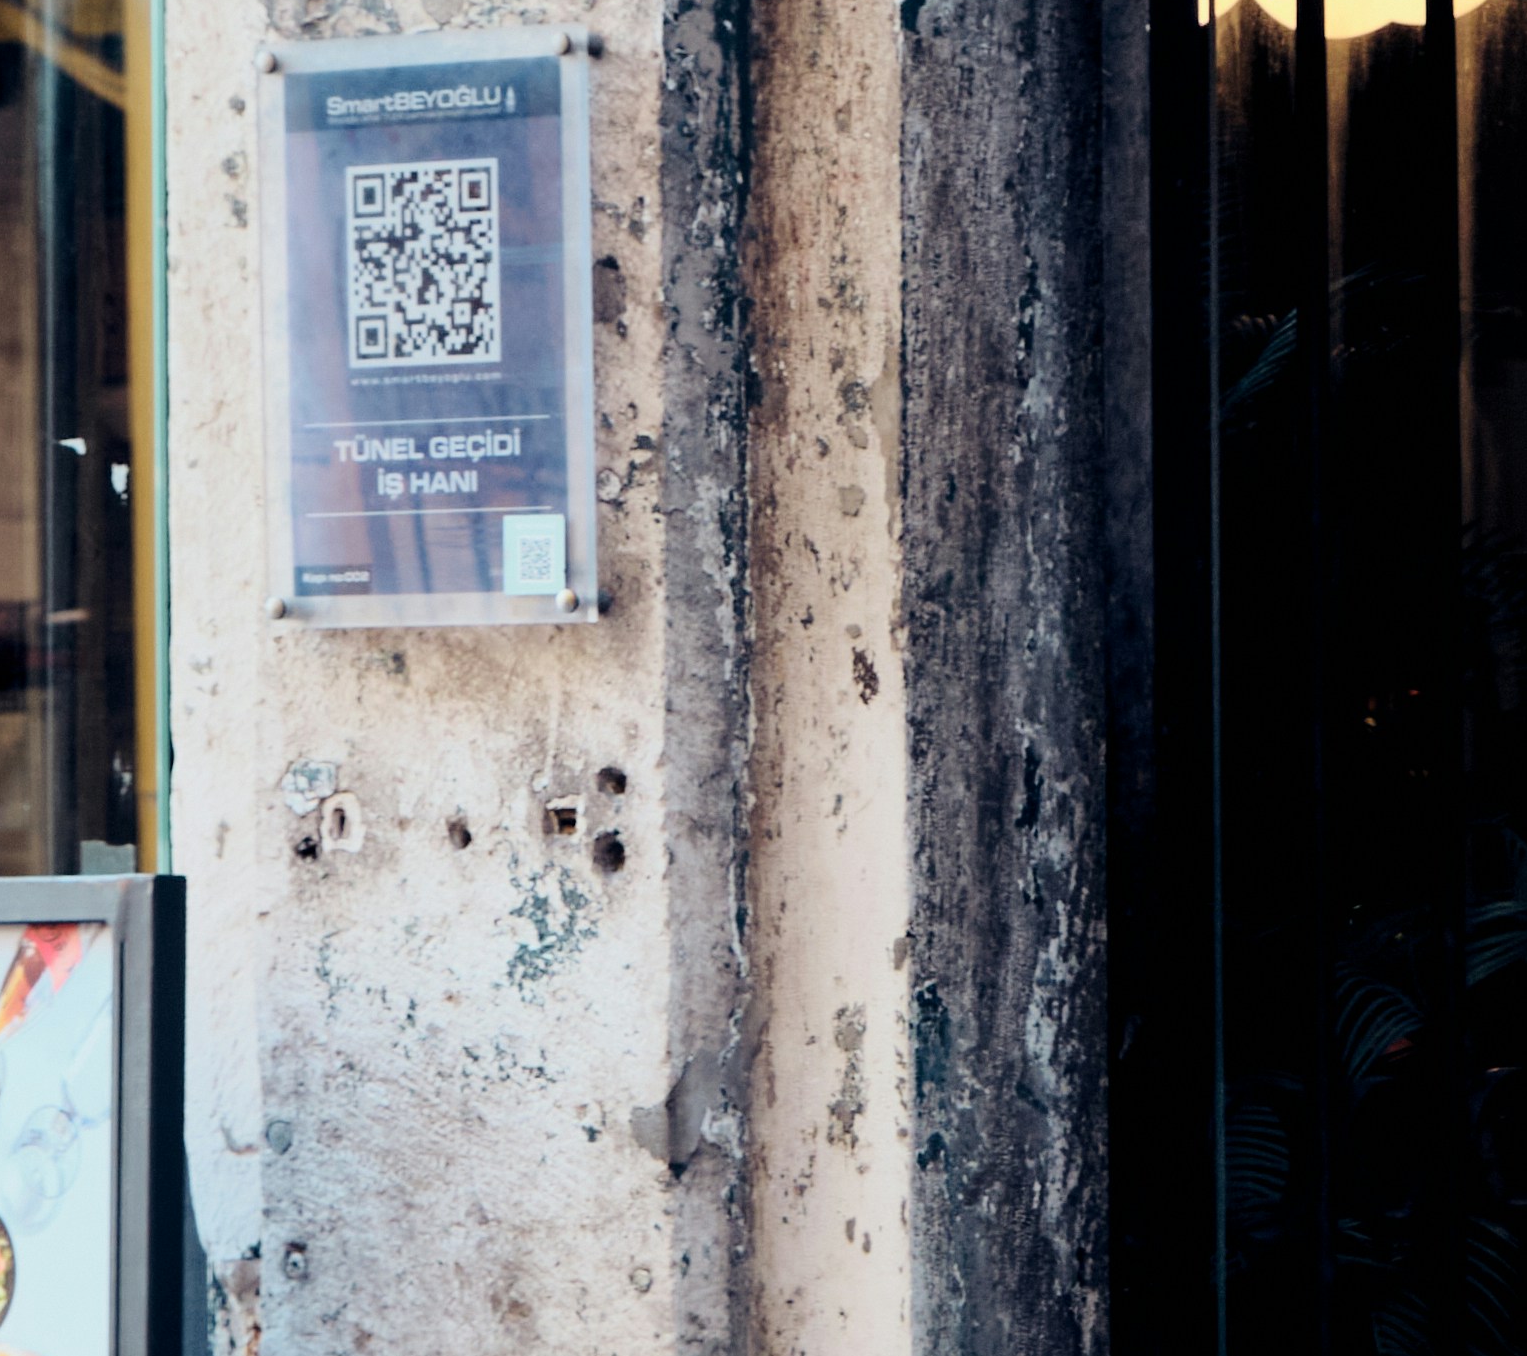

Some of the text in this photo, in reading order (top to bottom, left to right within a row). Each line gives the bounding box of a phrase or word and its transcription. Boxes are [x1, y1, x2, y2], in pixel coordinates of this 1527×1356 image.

[326, 84, 502, 116] SmartBEYOĞLU
[333, 428, 522, 464] TÜNEL GEÇİDİ
[377, 468, 479, 500] İŞ HANI
